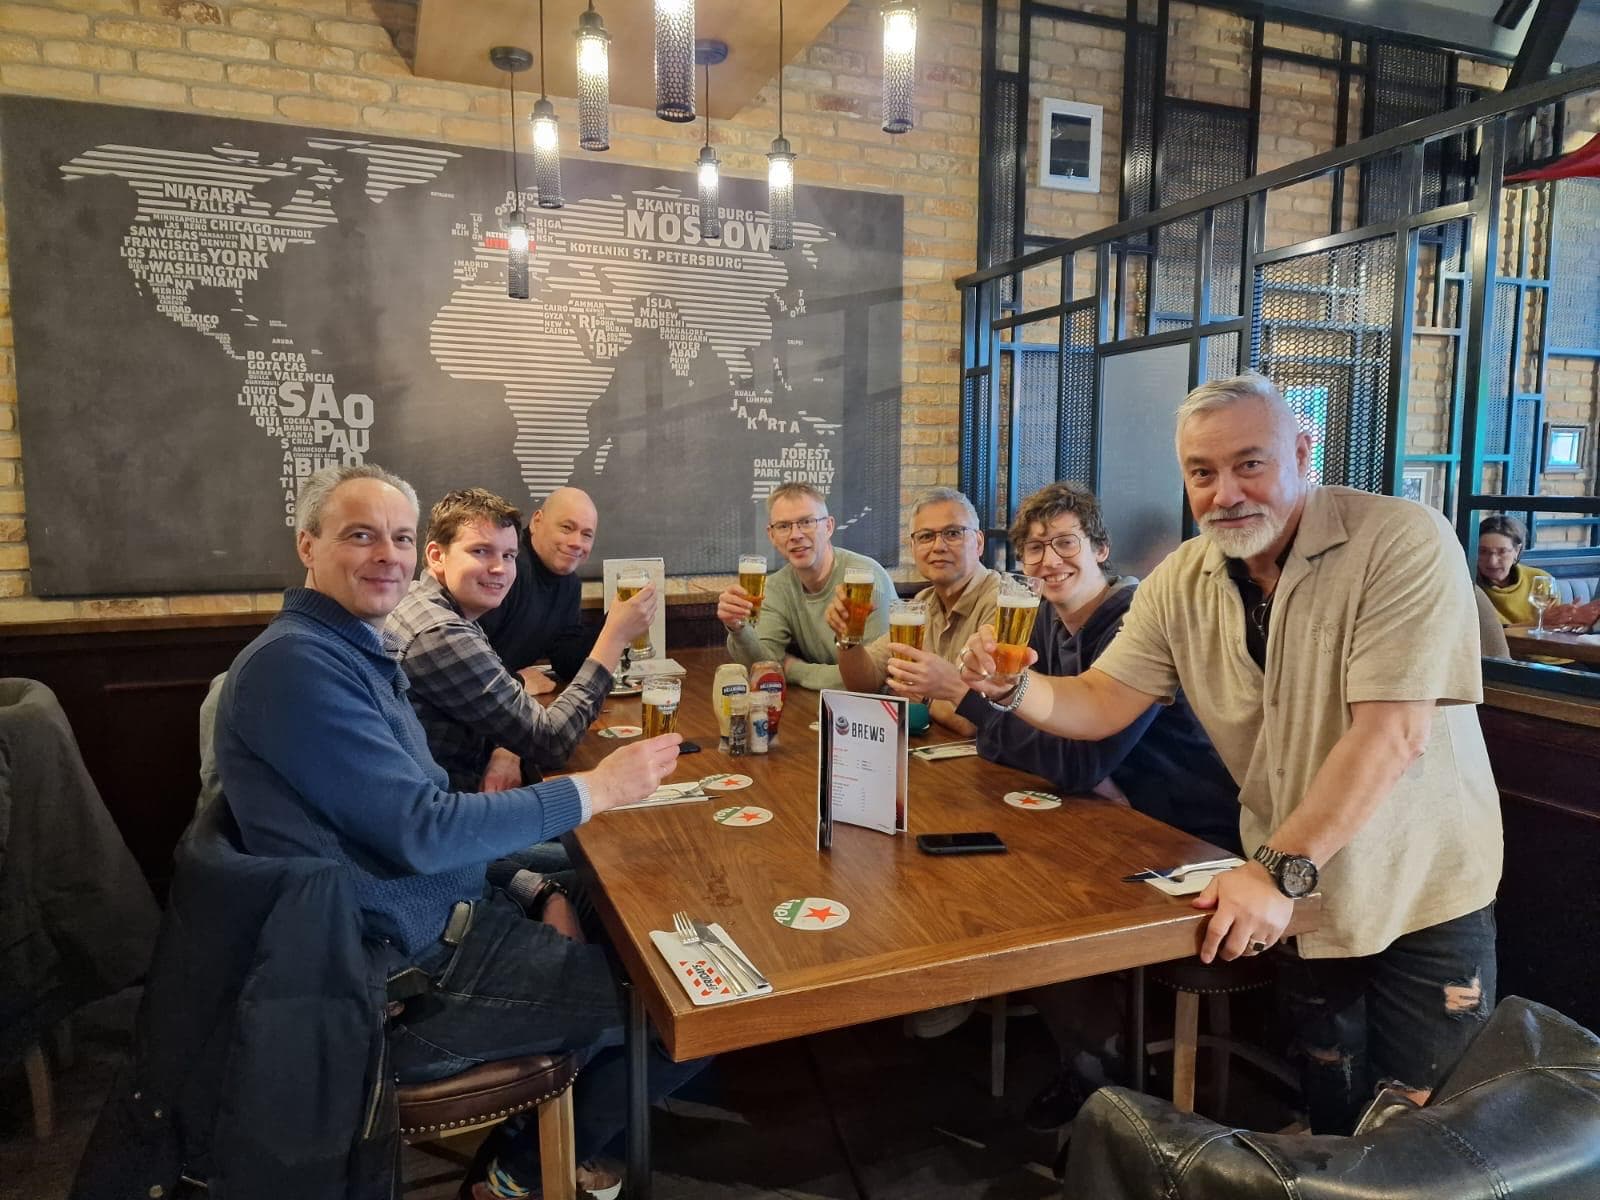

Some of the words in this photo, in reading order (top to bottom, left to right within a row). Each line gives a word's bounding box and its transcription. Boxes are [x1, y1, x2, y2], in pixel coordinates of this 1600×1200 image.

[164, 182, 247, 204] NIAGARA
[190, 200, 235, 214] FALLS
[164, 221, 180, 229] LAS
[184, 221, 207, 231] RENO
[210, 219, 272, 235] CHICAGO
[537, 218, 562, 229] RIGA
[130, 225, 157, 237] SAN
[158, 228, 198, 240] VEGAS
[273, 227, 313, 238] DETROIT
[627, 210, 770, 252] MOSOW
[123, 236, 200, 252] FRANCISCO
[200, 238, 239, 249] DENVER
[239, 234, 289, 253] NEW
[120, 246, 146, 258] LOS
[148, 248, 208, 263] ANGELES
[207, 247, 269, 269] YORK
[570, 242, 629, 257] KOTELNIKI
[632, 248, 652, 261] ST.
[656, 252, 743, 270] PETERSBURG
[149, 261, 258, 281] WASHINGTON
[200, 276, 243, 289] MIAMI
[152, 286, 189, 297] MERIDA
[156, 304, 192, 314] CIUDAD
[543, 303, 569, 312] CAIRO
[646, 297, 672, 309] ISLA
[173, 313, 220, 325] MEXICO
[544, 312, 564, 320] GYZA
[544, 320, 562, 328] NEW
[634, 317, 658, 329] BAD
[658, 319, 686, 327] DELHI
[544, 327, 569, 335] CAIRO
[668, 340, 701, 351] HYDER
[246, 350, 265, 361] BO
[270, 351, 305, 363] CARA
[670, 349, 698, 358] ABAD
[247, 360, 281, 371] GOTA
[284, 362, 308, 372] CAS
[273, 370, 335, 384] VALENCIA
[242, 386, 277, 395] QUITO
[237, 393, 279, 407] LIMA
[249, 406, 278, 417] ARE
[255, 416, 280, 428] QUI
[285, 431, 314, 439] SANTA
[291, 438, 314, 446] CRUZ
[781, 447, 831, 460] FOREST
[753, 458, 806, 469] OAKLANDS
[806, 459, 835, 472] HILL
[753, 468, 781, 478] PARK
[783, 470, 836, 484] SIDNEY
[851, 722, 886, 743] BREWS
